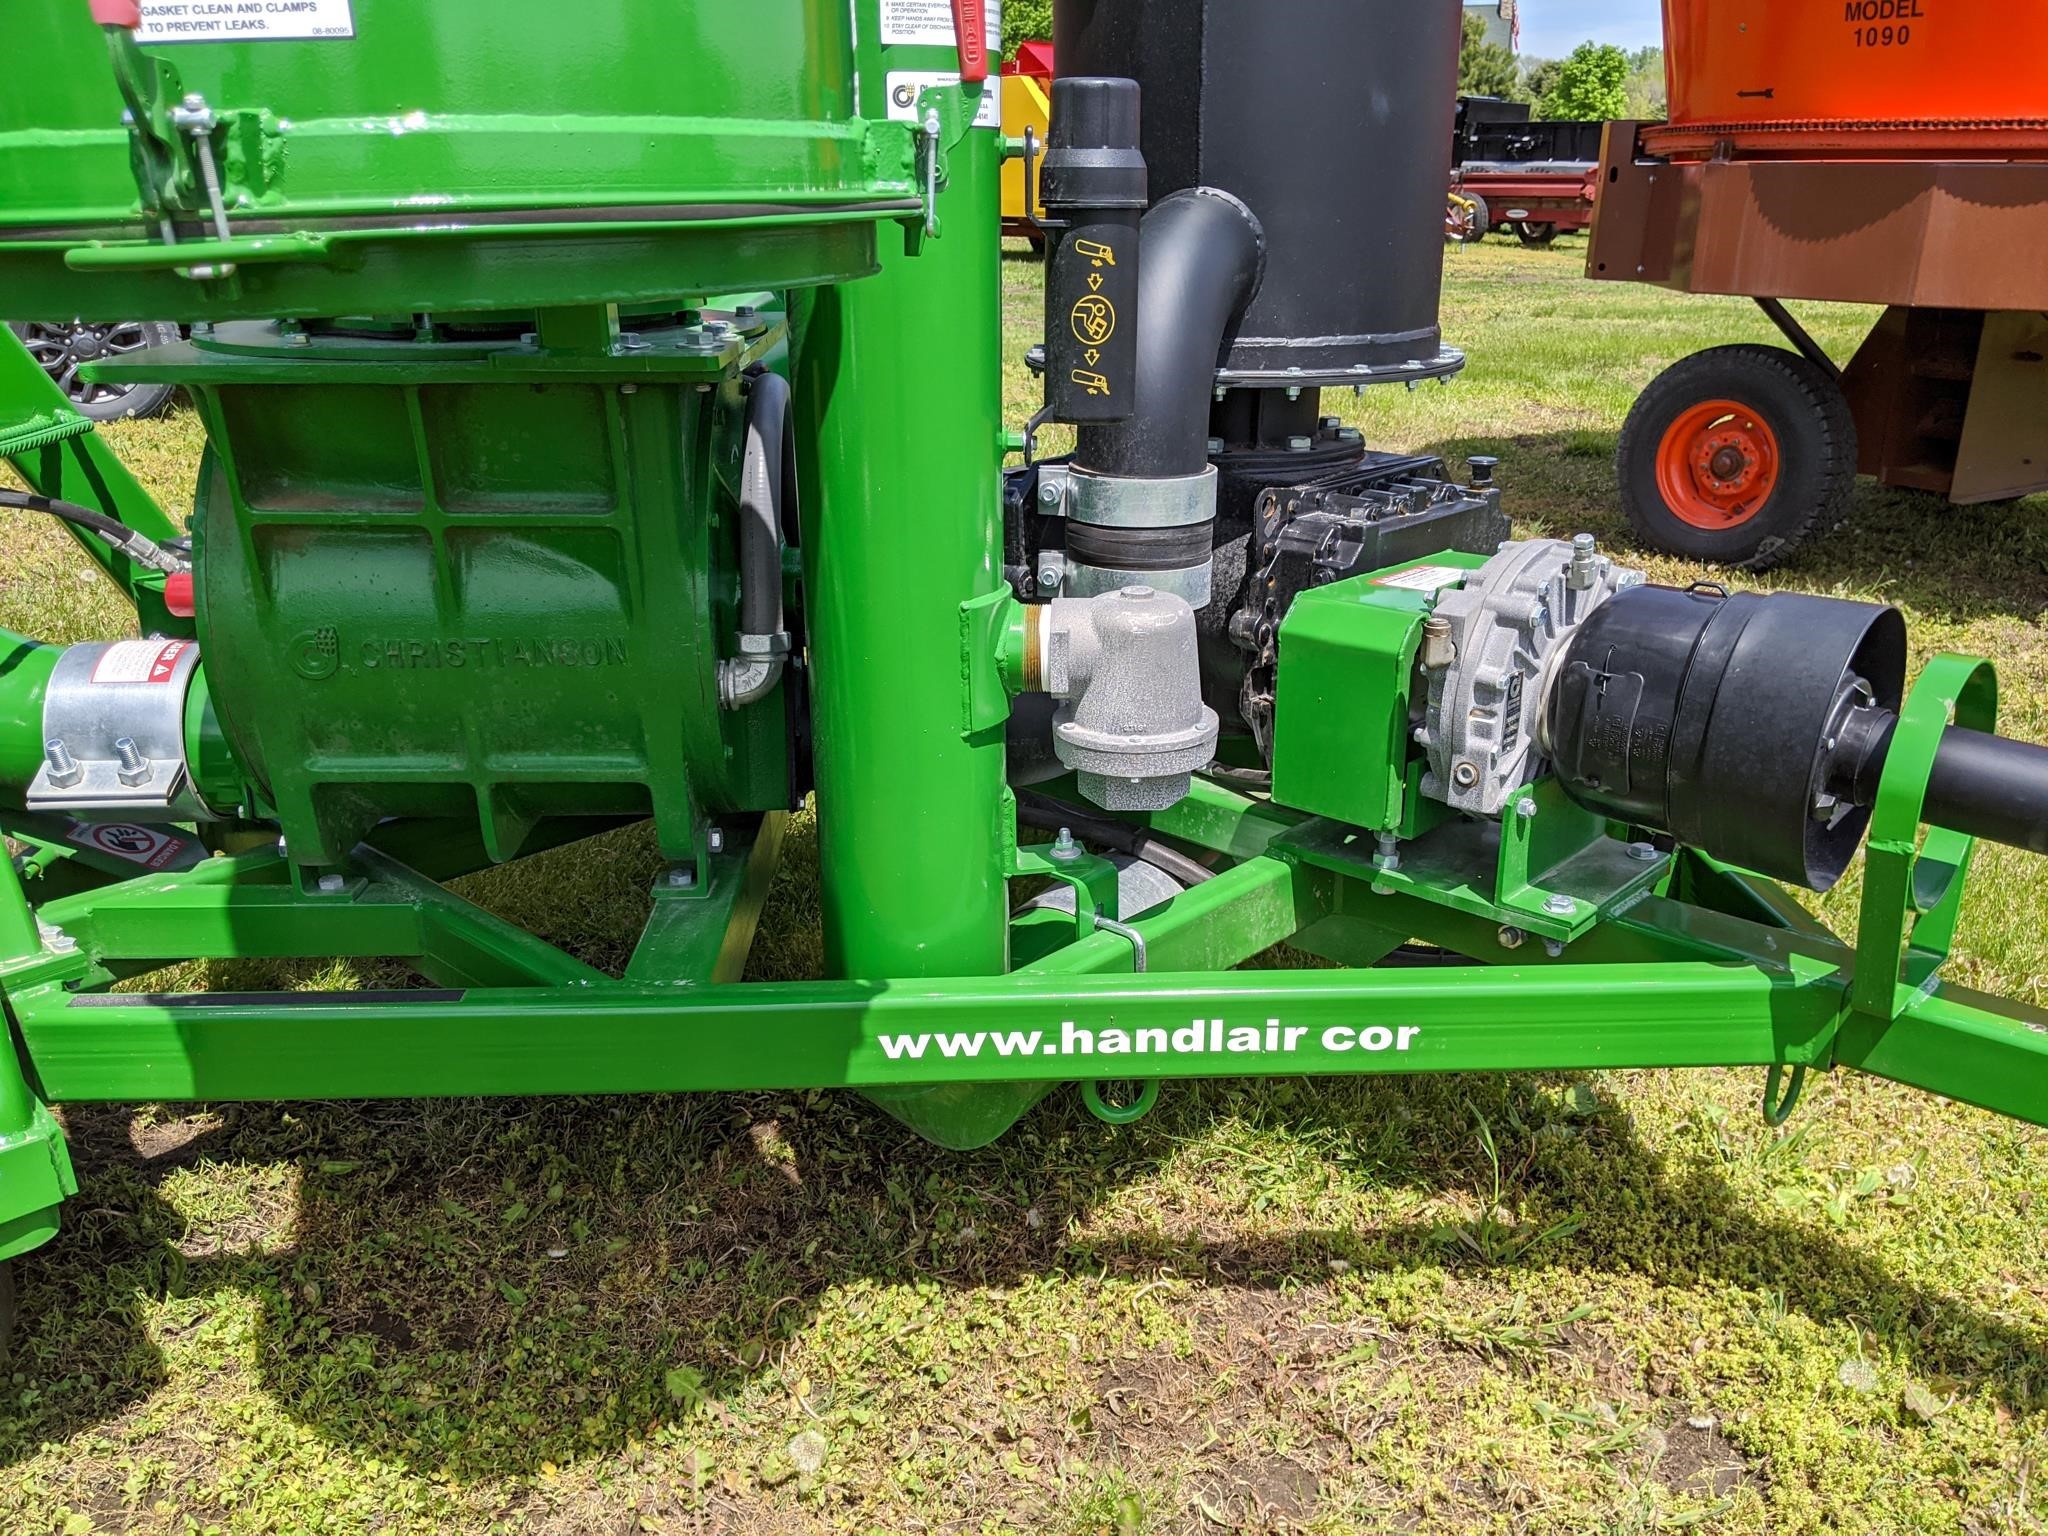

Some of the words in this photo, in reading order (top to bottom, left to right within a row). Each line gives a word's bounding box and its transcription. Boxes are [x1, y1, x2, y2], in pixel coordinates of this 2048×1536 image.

[141, 5, 188, 16] GASKET
[192, 4, 233, 15] CLEAN
[237, 3, 262, 13] AND
[266, 2, 317, 12] CLAMPS
[1845, 0, 1924, 22] MODEL
[148, 22, 163, 33] TO
[166, 21, 221, 32] PREVENT
[225, 19, 269, 31] LEAKS.
[312, 26, 350, 35] 08-80095
[1854, 24, 1910, 47] 1090
[361, 636, 632, 668] CHRISTIANSON
[877, 1018, 1309, 1060] www.handlair
